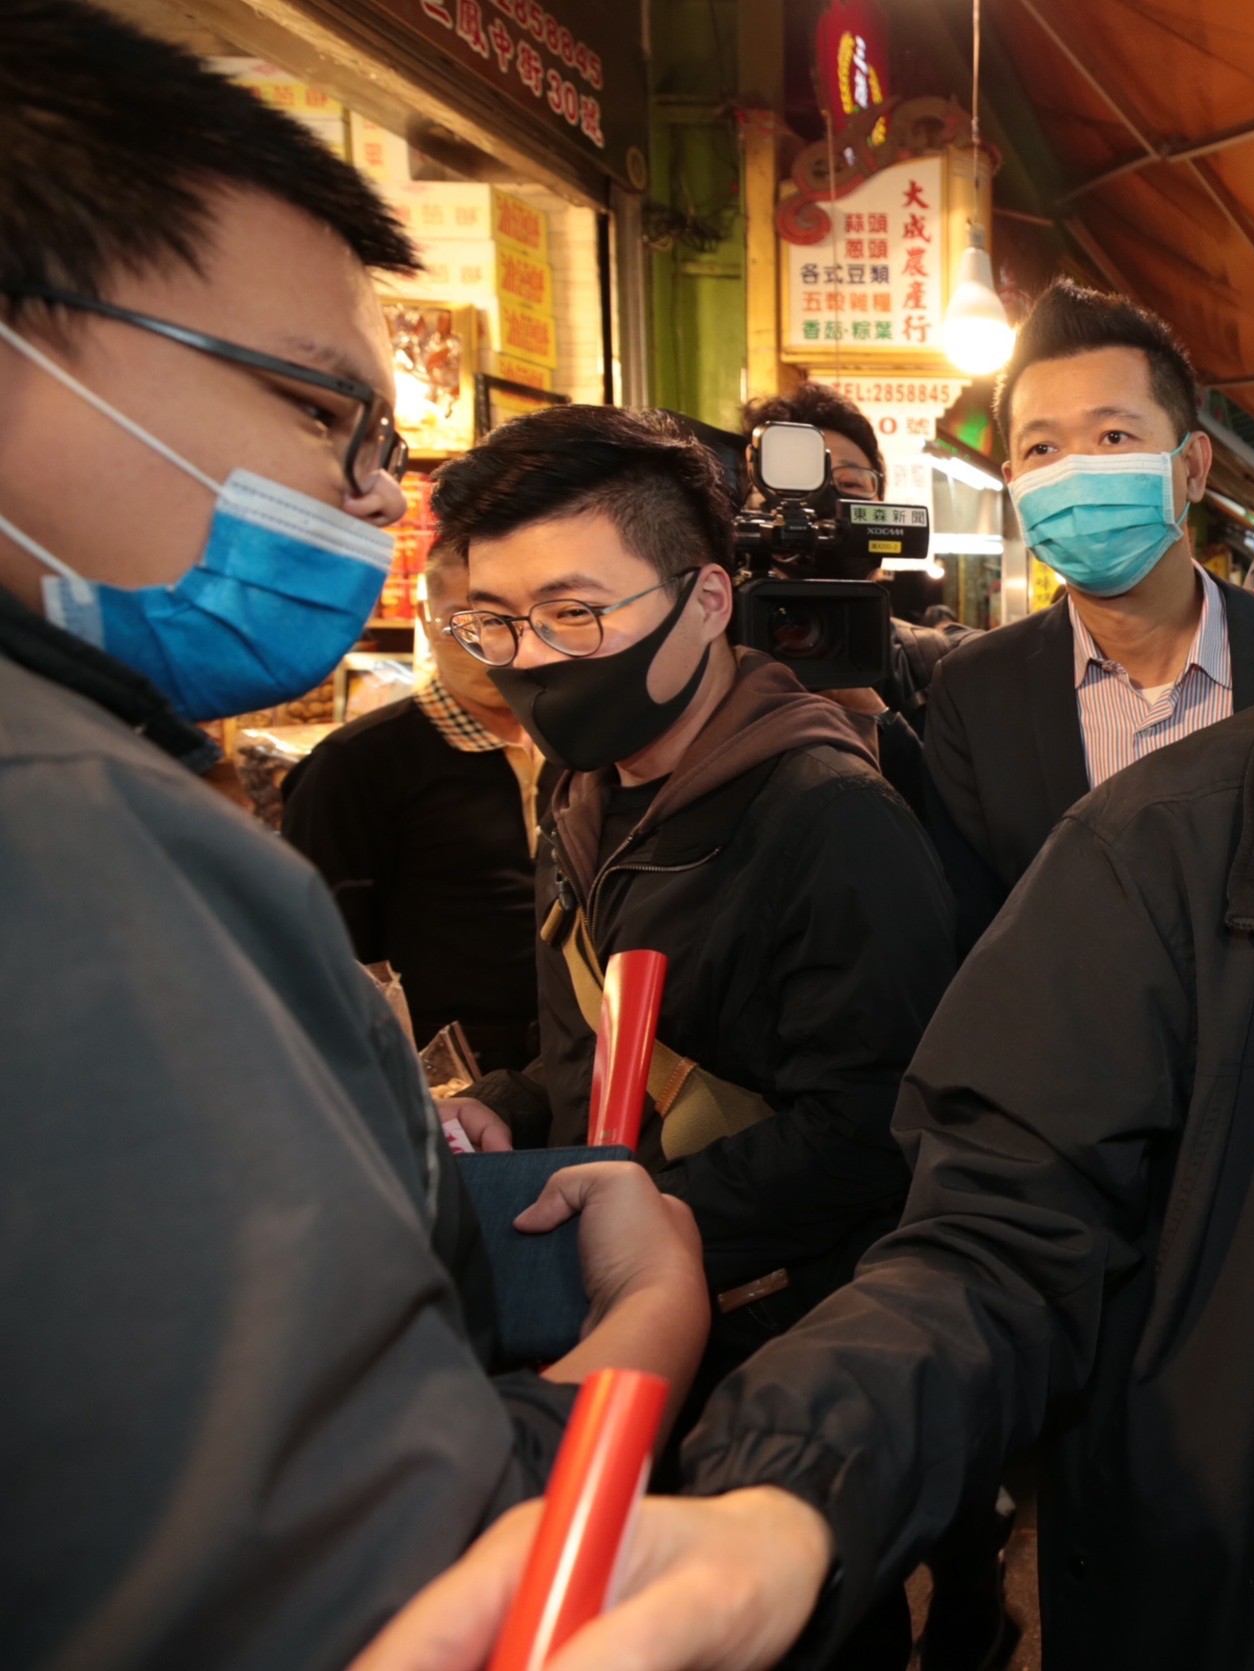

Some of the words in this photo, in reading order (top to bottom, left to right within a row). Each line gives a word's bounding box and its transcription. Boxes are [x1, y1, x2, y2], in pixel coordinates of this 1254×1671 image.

[902, 179, 931, 343] 大成農產行
[801, 263, 889, 284] 各式豆類
[853, 508, 925, 524] 東森新聞
